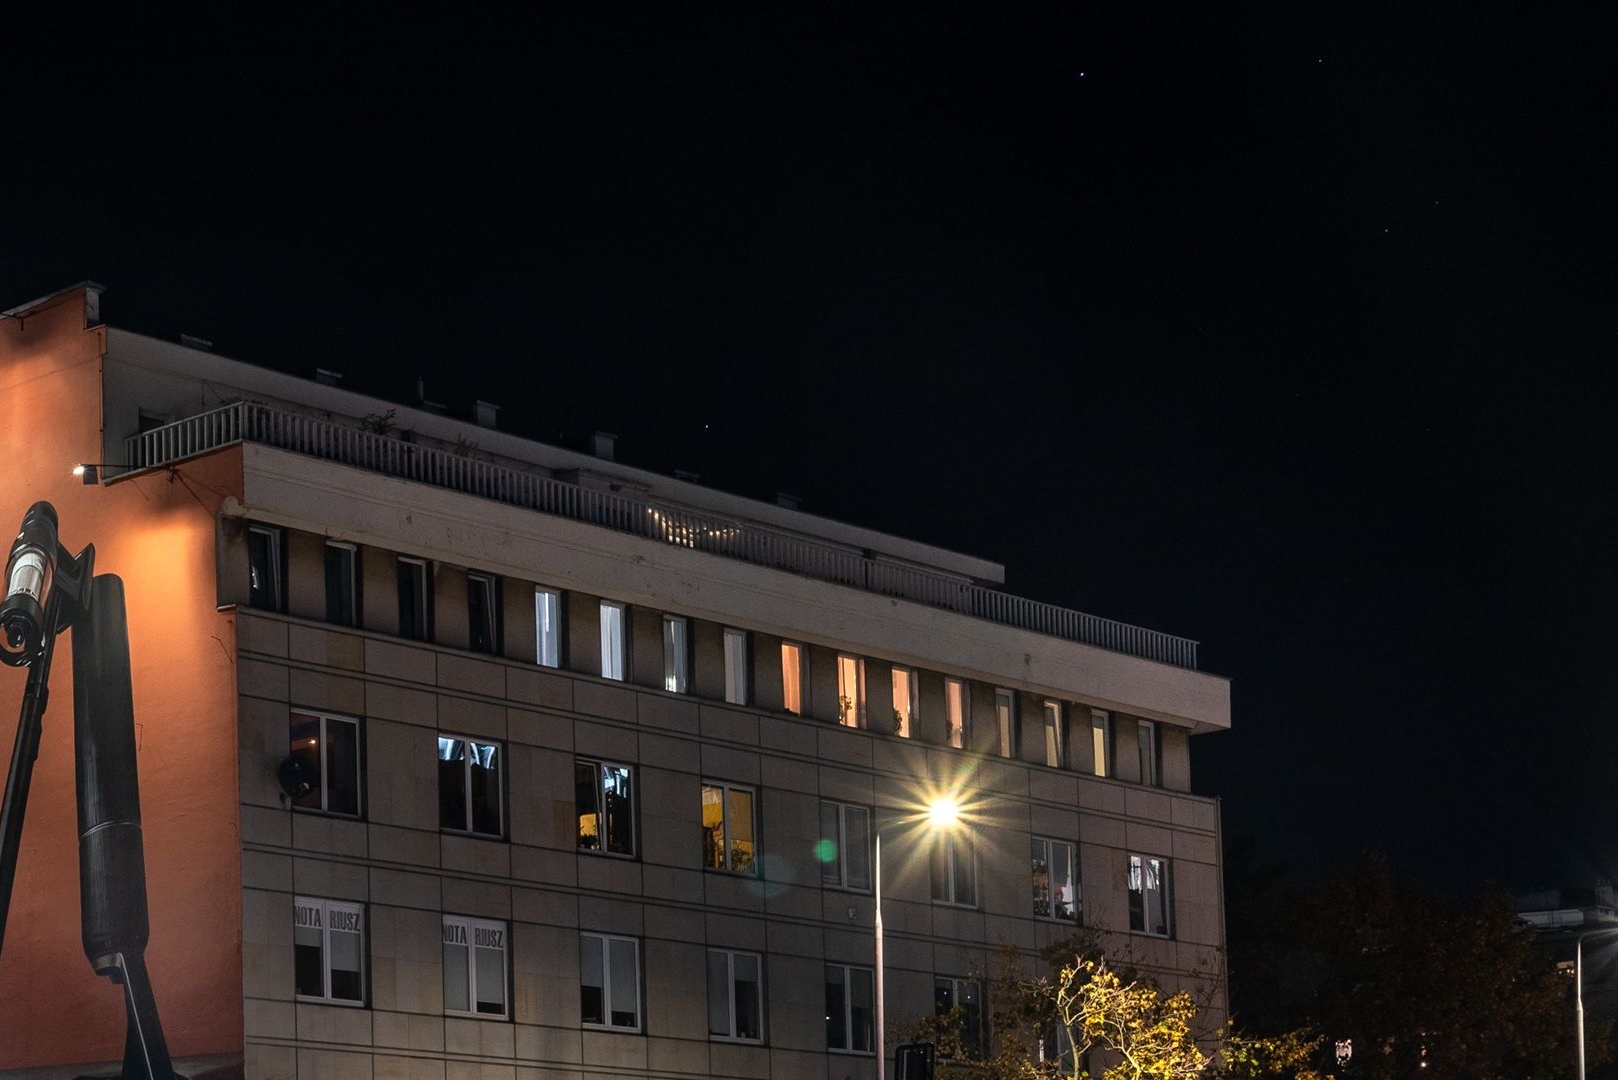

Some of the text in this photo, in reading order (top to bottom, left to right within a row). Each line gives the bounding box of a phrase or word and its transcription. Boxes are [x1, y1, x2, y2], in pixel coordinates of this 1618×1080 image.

[294, 905, 361, 932] NOTA RIUSZ
[474, 927, 504, 949] RIUSZ
